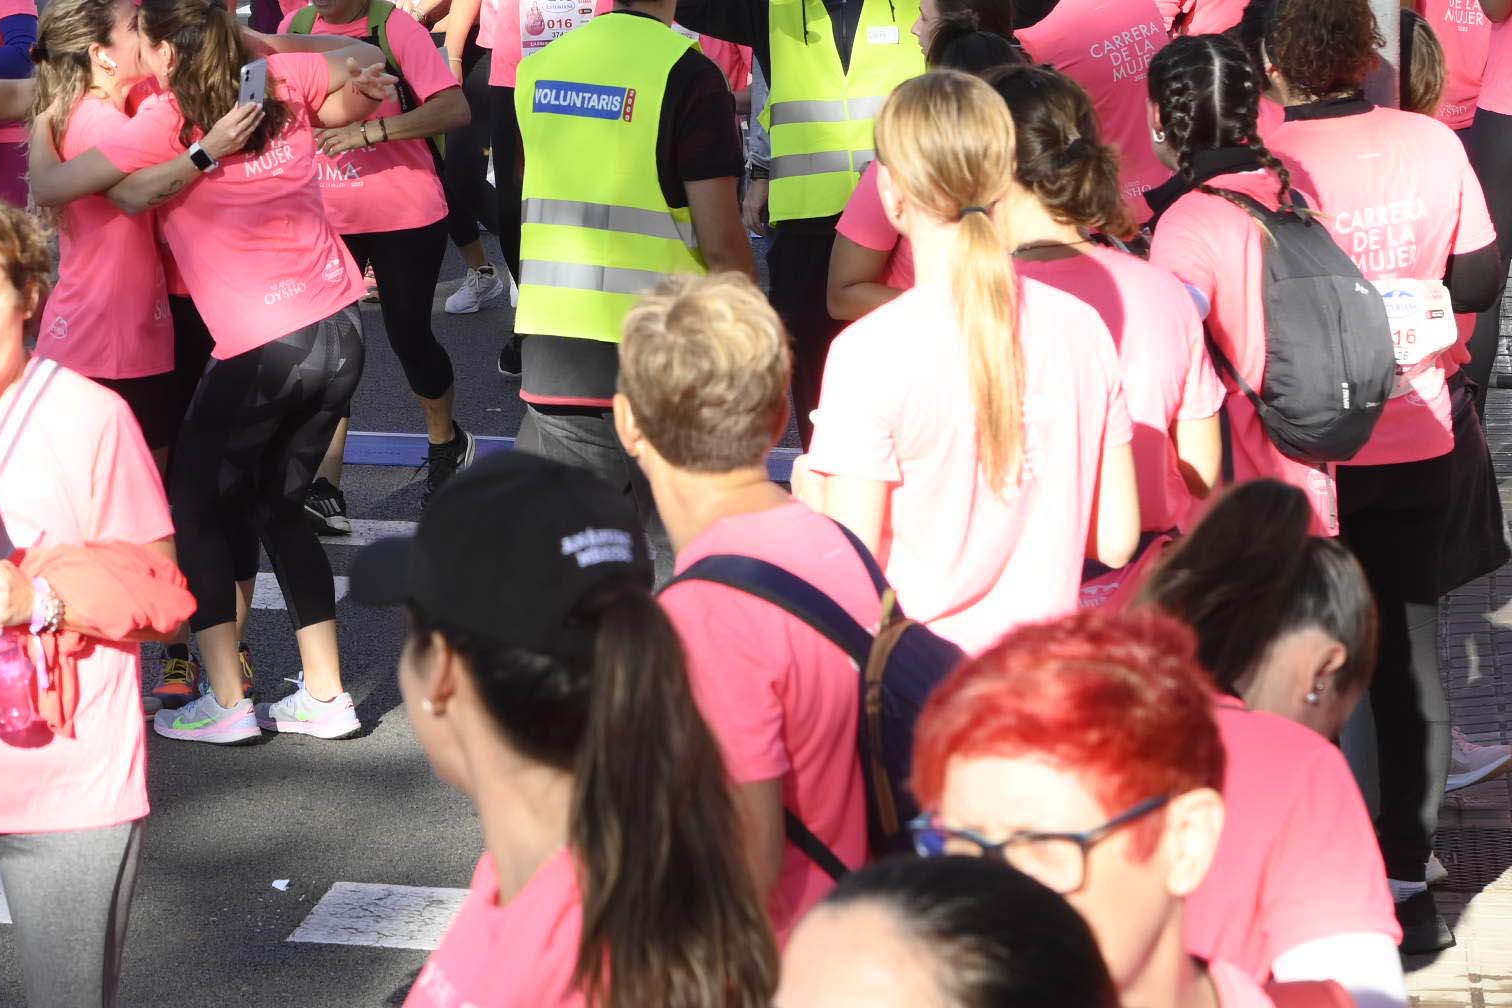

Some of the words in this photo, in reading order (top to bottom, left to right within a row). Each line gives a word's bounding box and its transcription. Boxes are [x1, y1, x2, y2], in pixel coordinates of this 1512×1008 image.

[547, 18, 573, 29] 016
[1444, 8, 1485, 26] MUJER
[1090, 21, 1159, 59] CARRERA
[1109, 47, 1132, 67] DE
[1136, 39, 1155, 56] LA
[535, 88, 621, 112] VOLUNTARIS
[244, 145, 295, 178] MUJER
[1335, 197, 1427, 235] CARRERA
[1352, 229, 1381, 252] DE
[1387, 223, 1416, 243] LA
[1350, 245, 1417, 273] MUJER
[1394, 328, 1417, 348] 16
